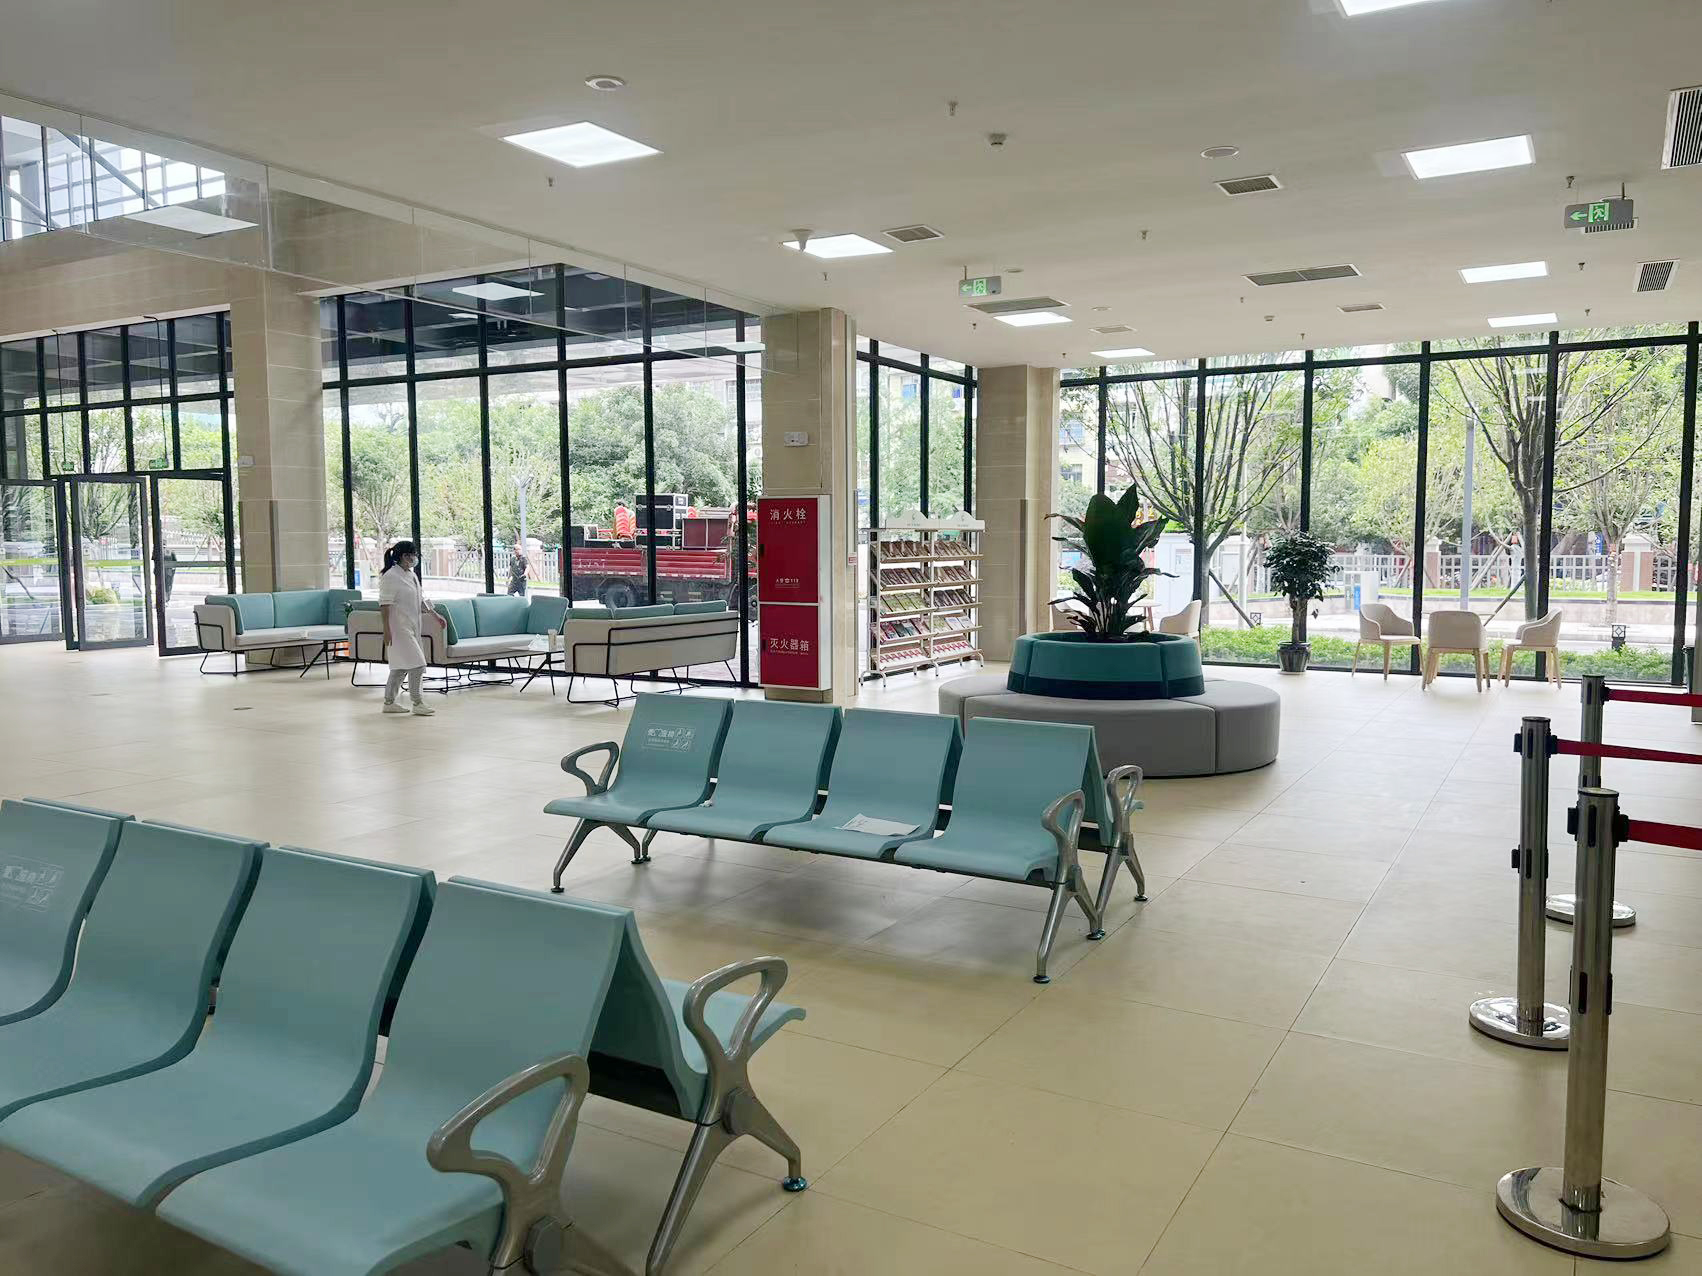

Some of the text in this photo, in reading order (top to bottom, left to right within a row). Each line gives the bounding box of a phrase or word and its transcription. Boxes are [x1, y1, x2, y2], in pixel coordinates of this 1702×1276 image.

[770, 508, 806, 520] 消火栓
[770, 638, 809, 651] 灭火器箱
